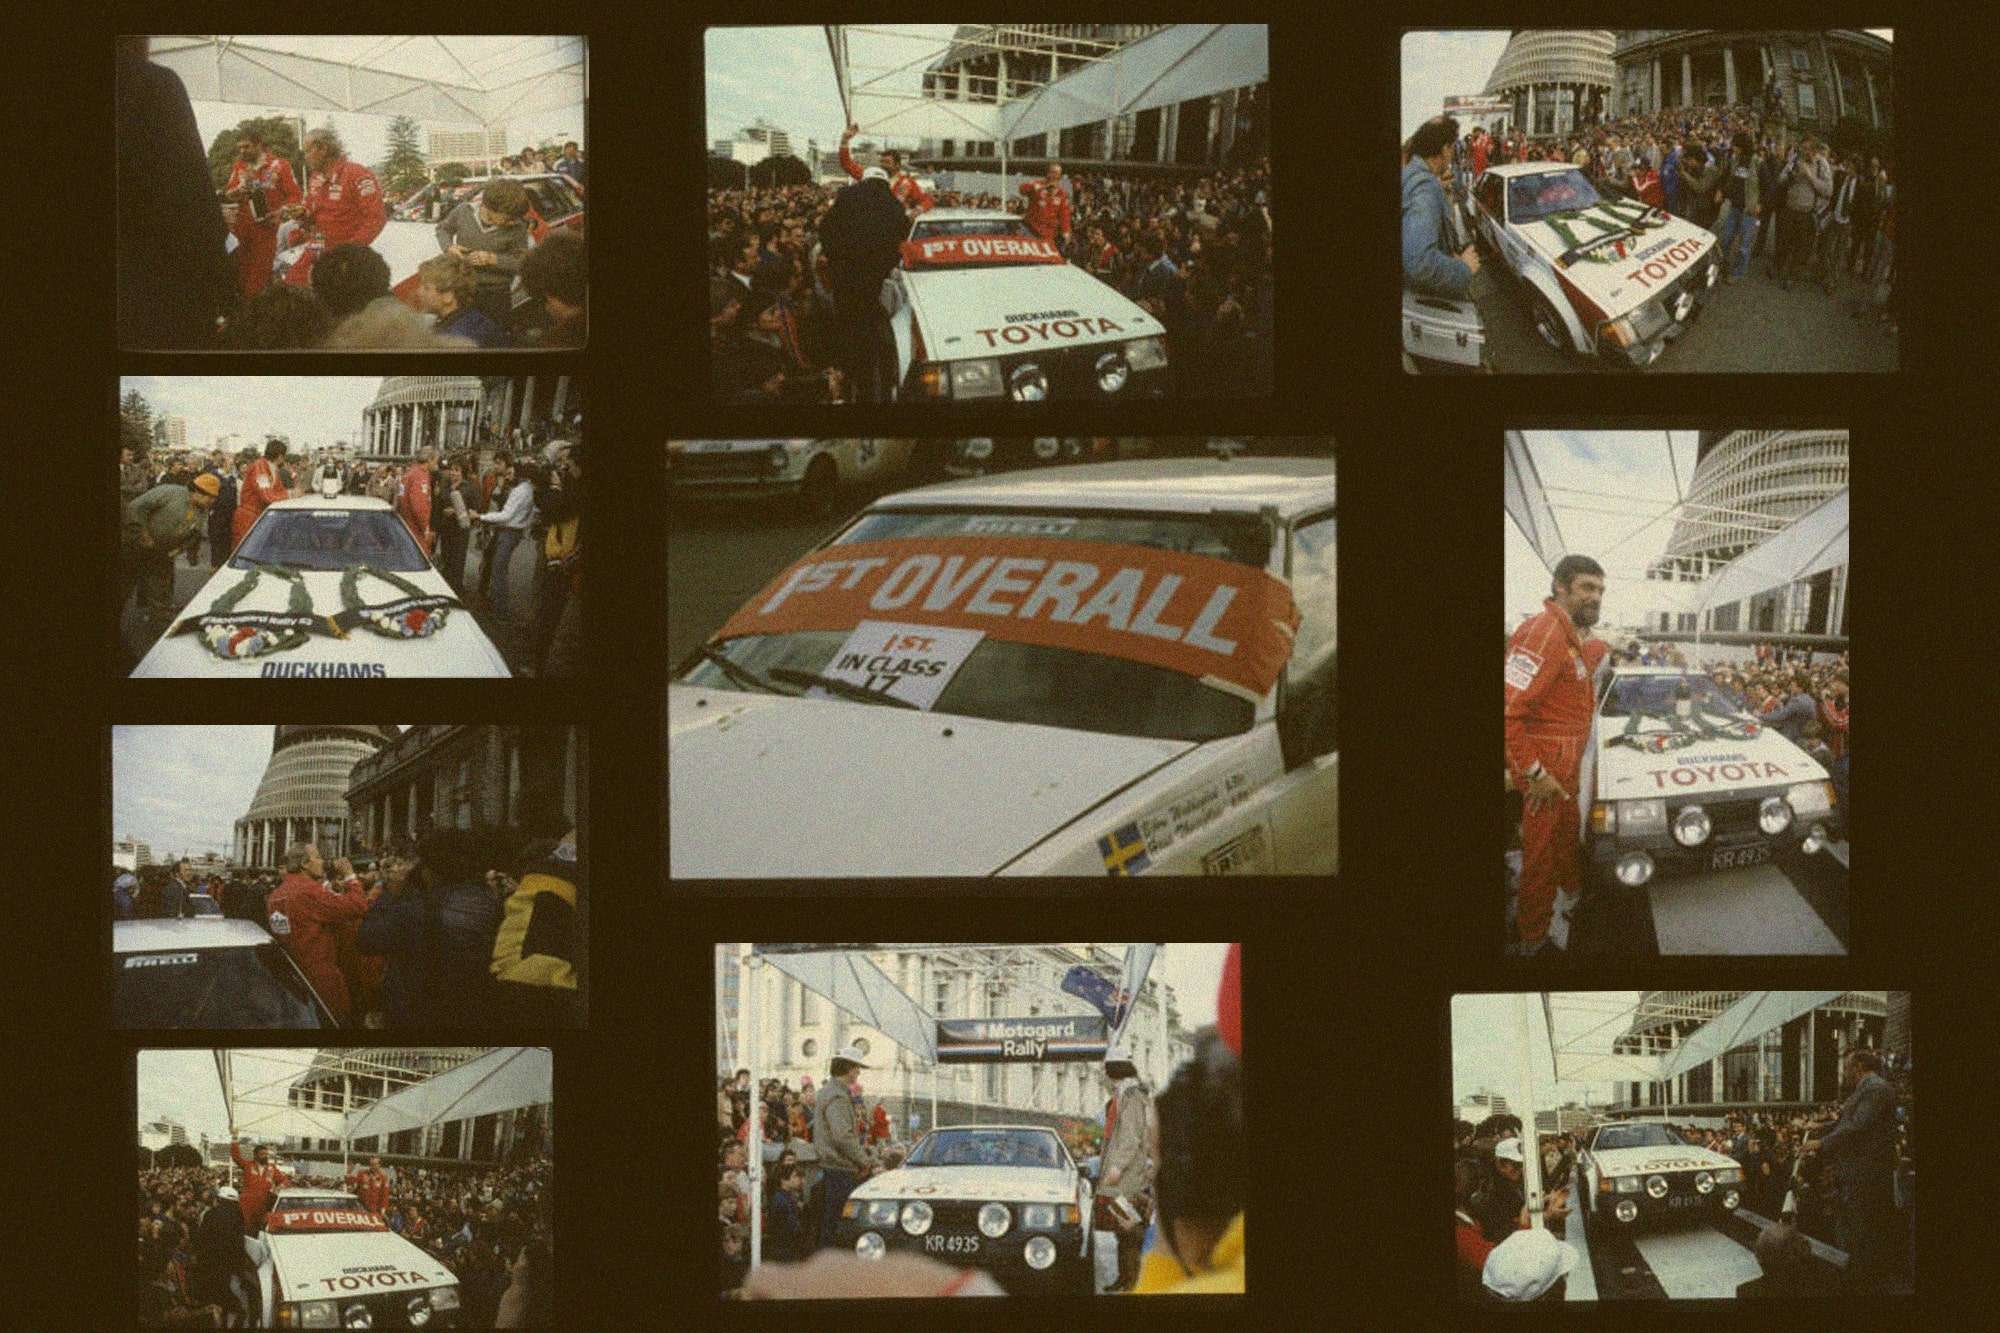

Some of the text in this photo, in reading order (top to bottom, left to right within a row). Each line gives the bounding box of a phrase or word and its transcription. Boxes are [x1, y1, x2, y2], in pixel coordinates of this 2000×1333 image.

[963, 239, 1059, 258] OVERALL
[1628, 238, 1703, 287] TOYOTA
[978, 318, 1123, 347] TOYOTA
[759, 553, 1240, 657] 1ST OVERALL
[261, 662, 387, 679] DUCKHAMS
[836, 653, 948, 677] IN CLASS
[863, 672, 901, 694] 17
[1648, 763, 1787, 788] TOYOTA
[990, 1021, 1075, 1041] Motogard
[1003, 1039, 1046, 1058] Rally
[314, 1211, 385, 1227] OVERALL
[925, 1235, 980, 1252] KR 4935
[320, 1271, 429, 1292] TOYOTA
